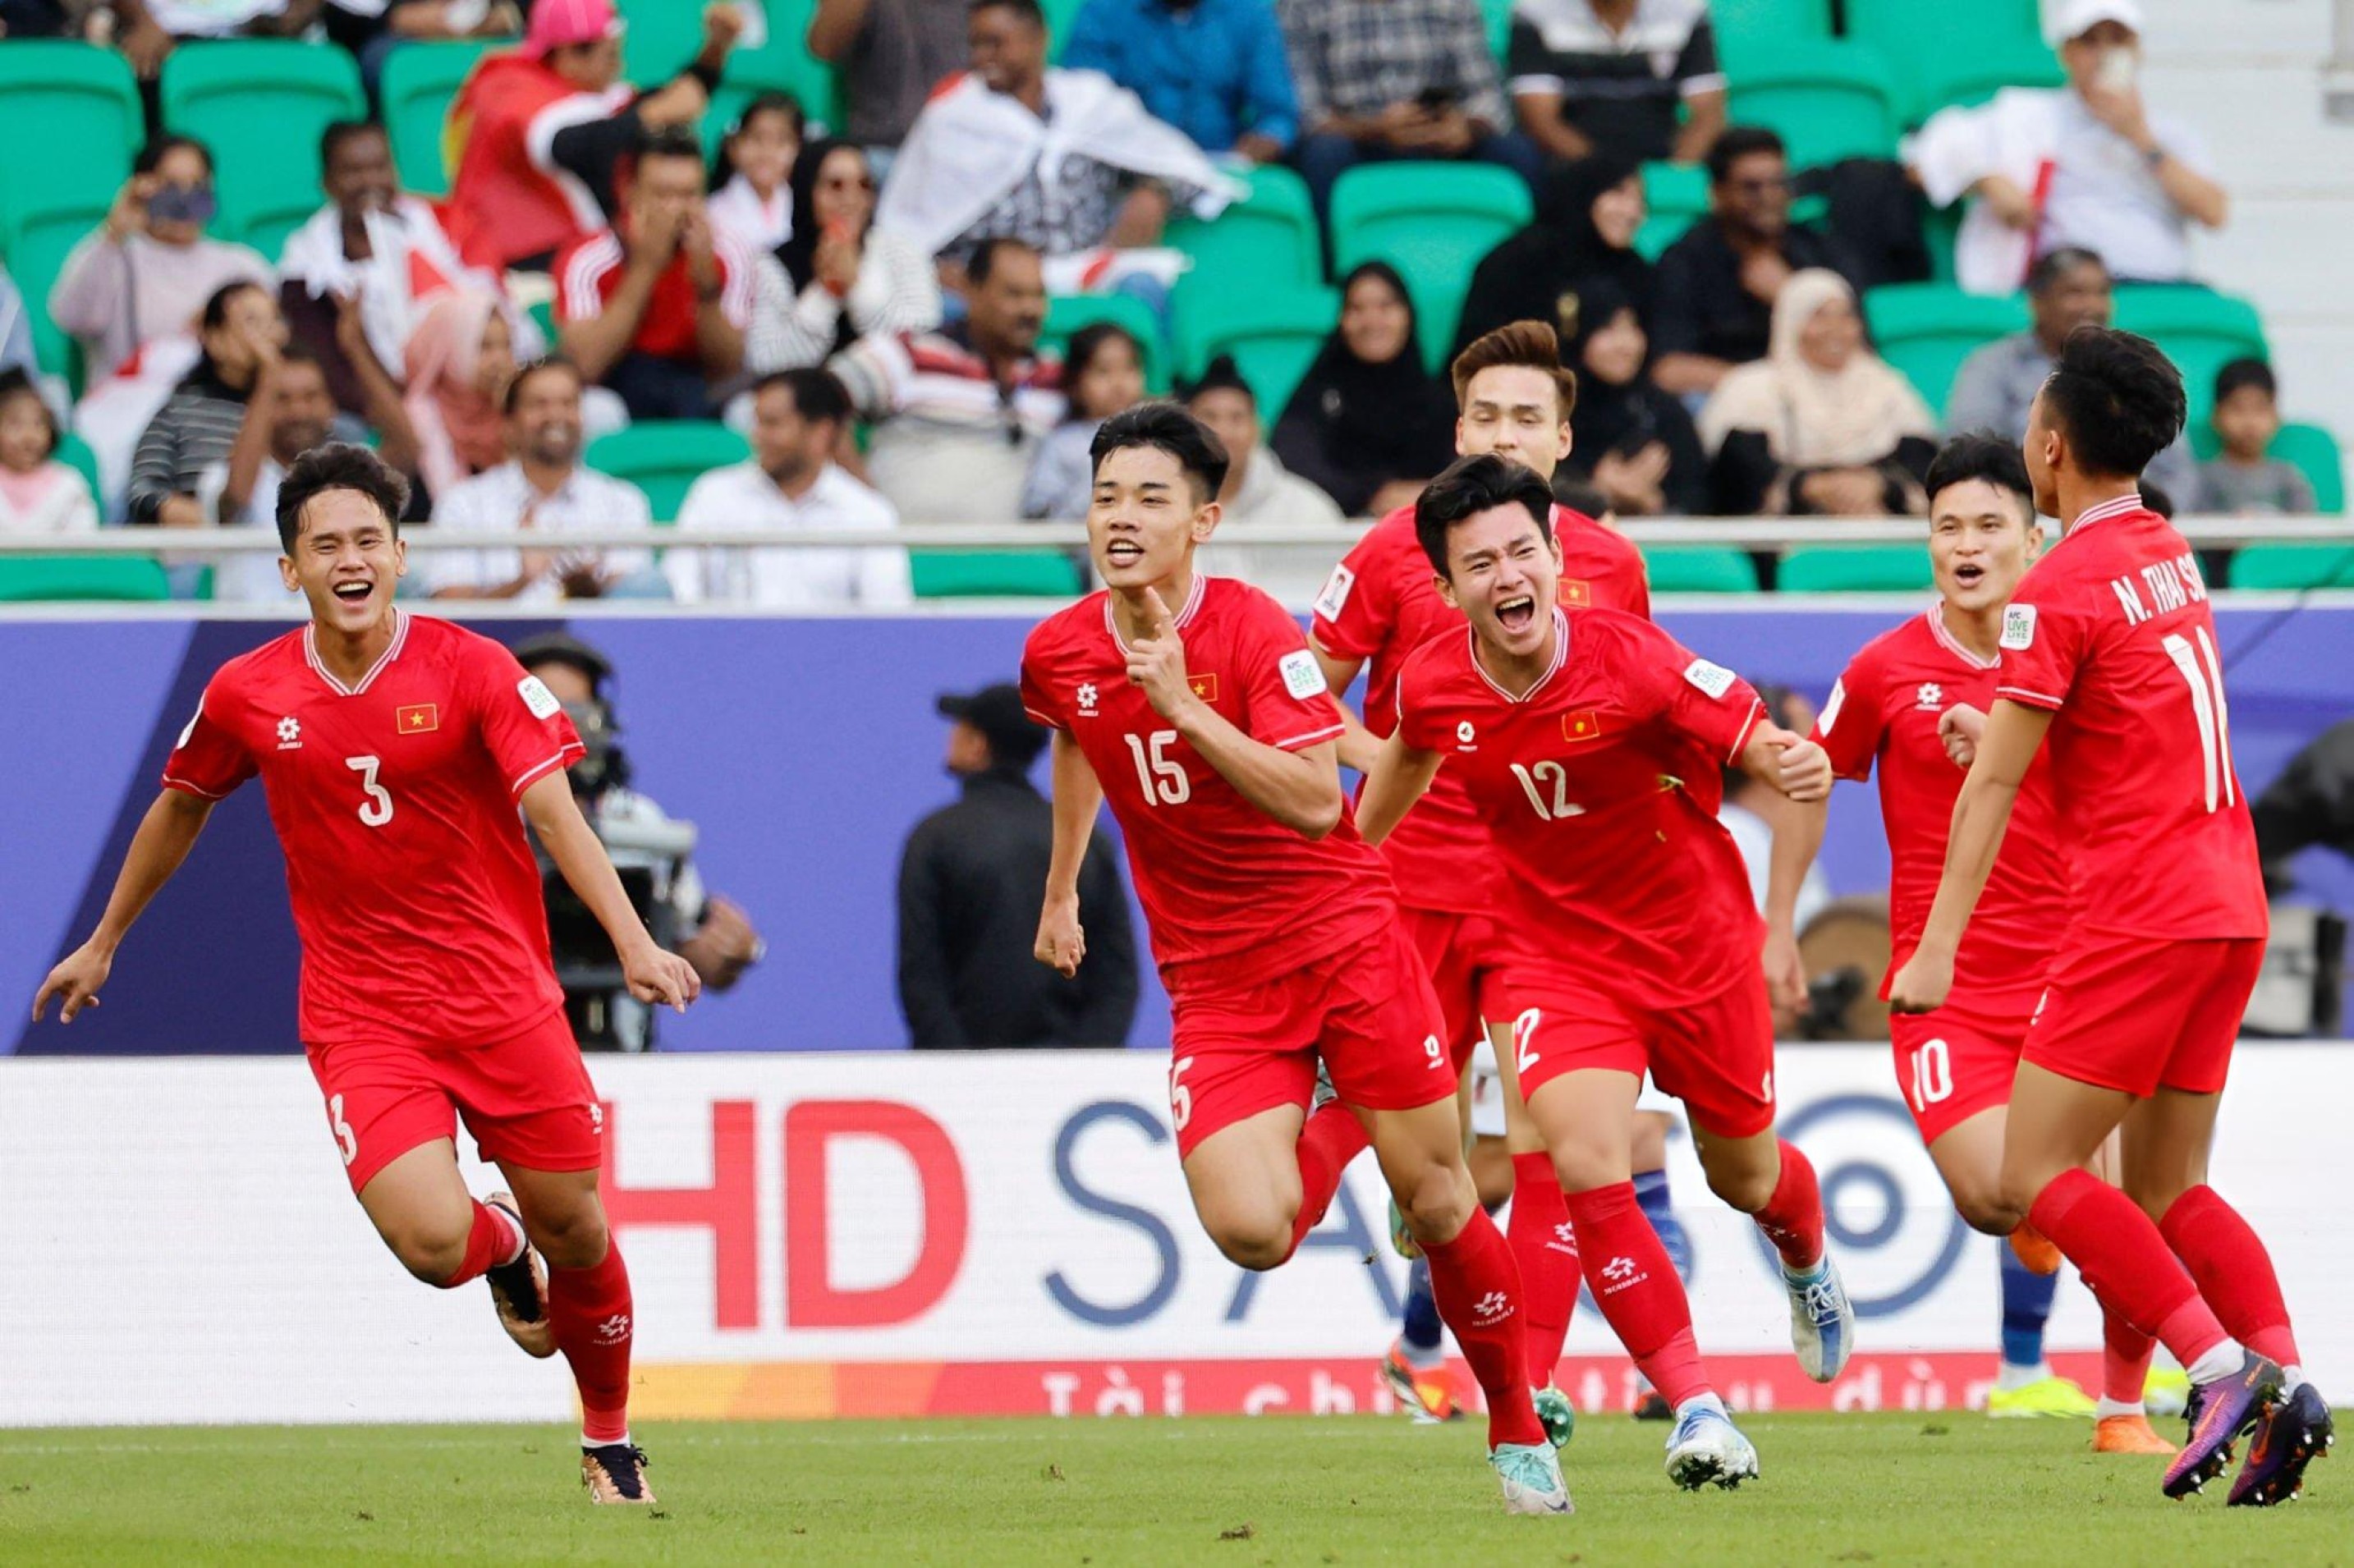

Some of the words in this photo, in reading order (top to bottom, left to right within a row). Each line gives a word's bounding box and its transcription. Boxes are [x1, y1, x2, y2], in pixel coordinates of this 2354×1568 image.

[2008, 612, 2021, 620] AFC
[2110, 575, 2153, 626] N.
[2161, 625, 2235, 814] 11
[345, 755, 394, 827] 3
[1123, 729, 1191, 806] 15
[1509, 760, 1586, 822] 12
[1911, 1038, 1954, 1113] 10
[330, 1093, 358, 1167] 3
[599, 1099, 967, 1331] HD
[1042, 1365, 1186, 1416] Tài
